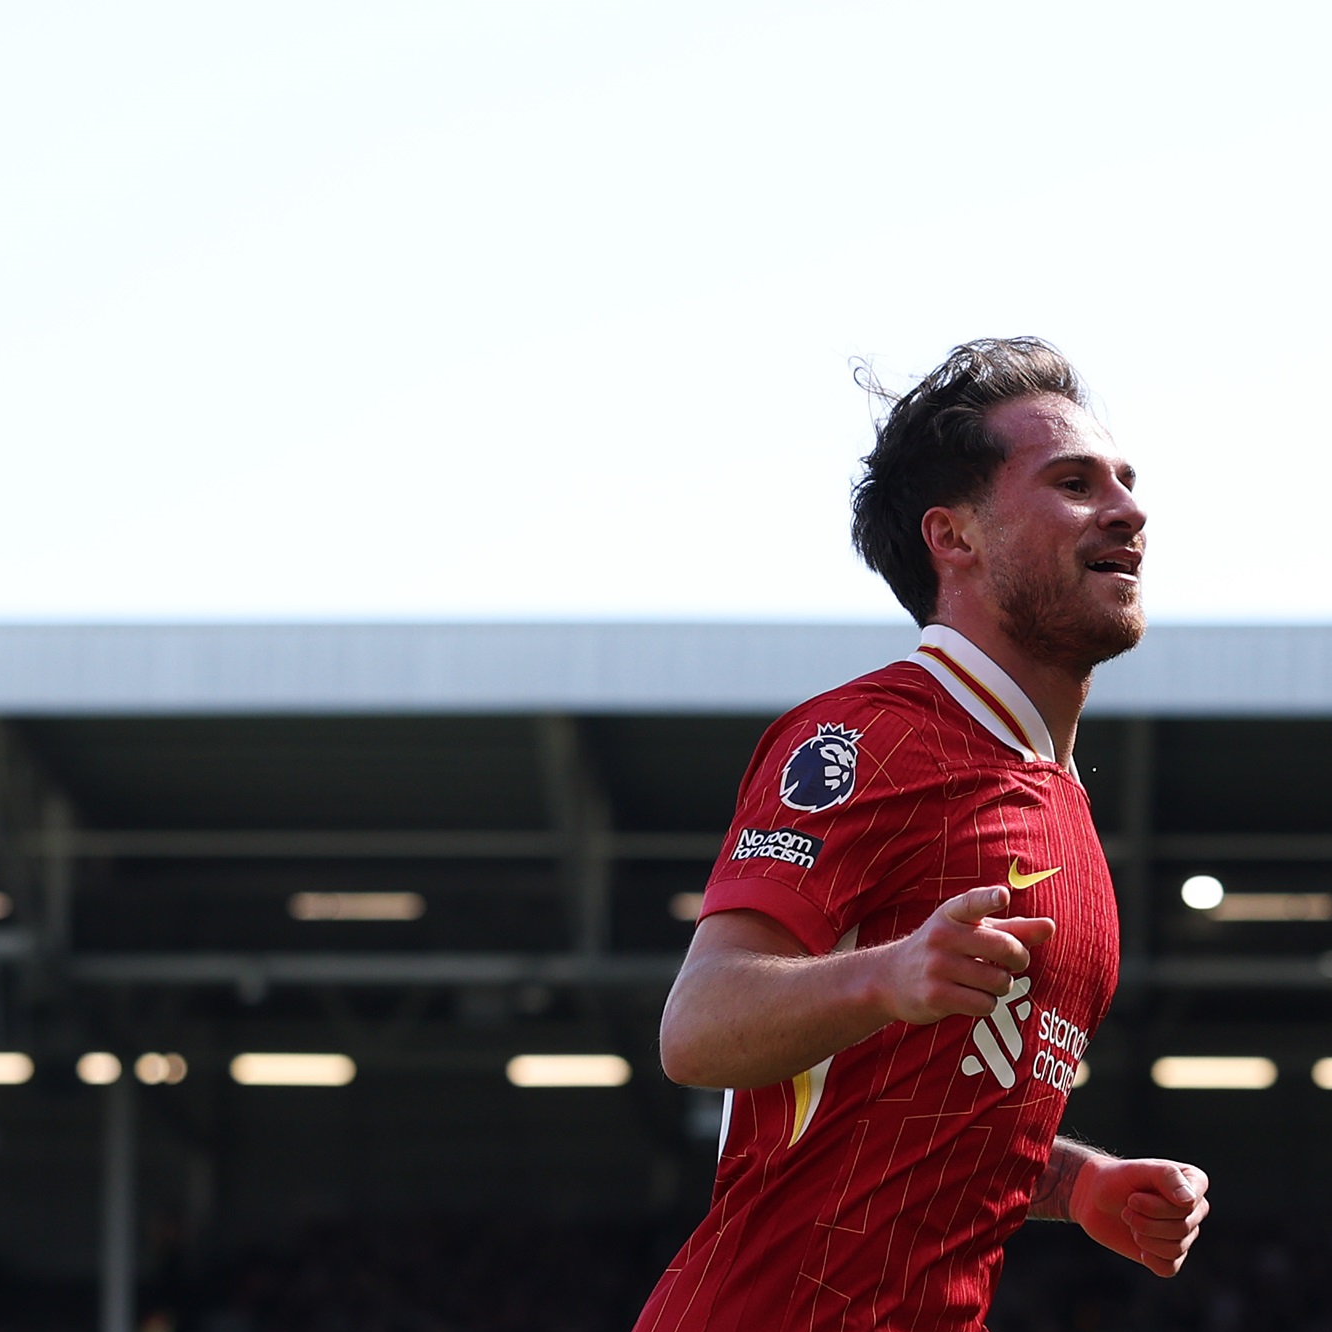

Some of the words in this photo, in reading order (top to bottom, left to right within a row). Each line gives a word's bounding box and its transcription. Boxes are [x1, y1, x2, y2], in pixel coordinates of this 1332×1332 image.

[738, 829, 764, 847] No
[763, 831, 812, 853] room
[753, 844, 814, 869] racism
